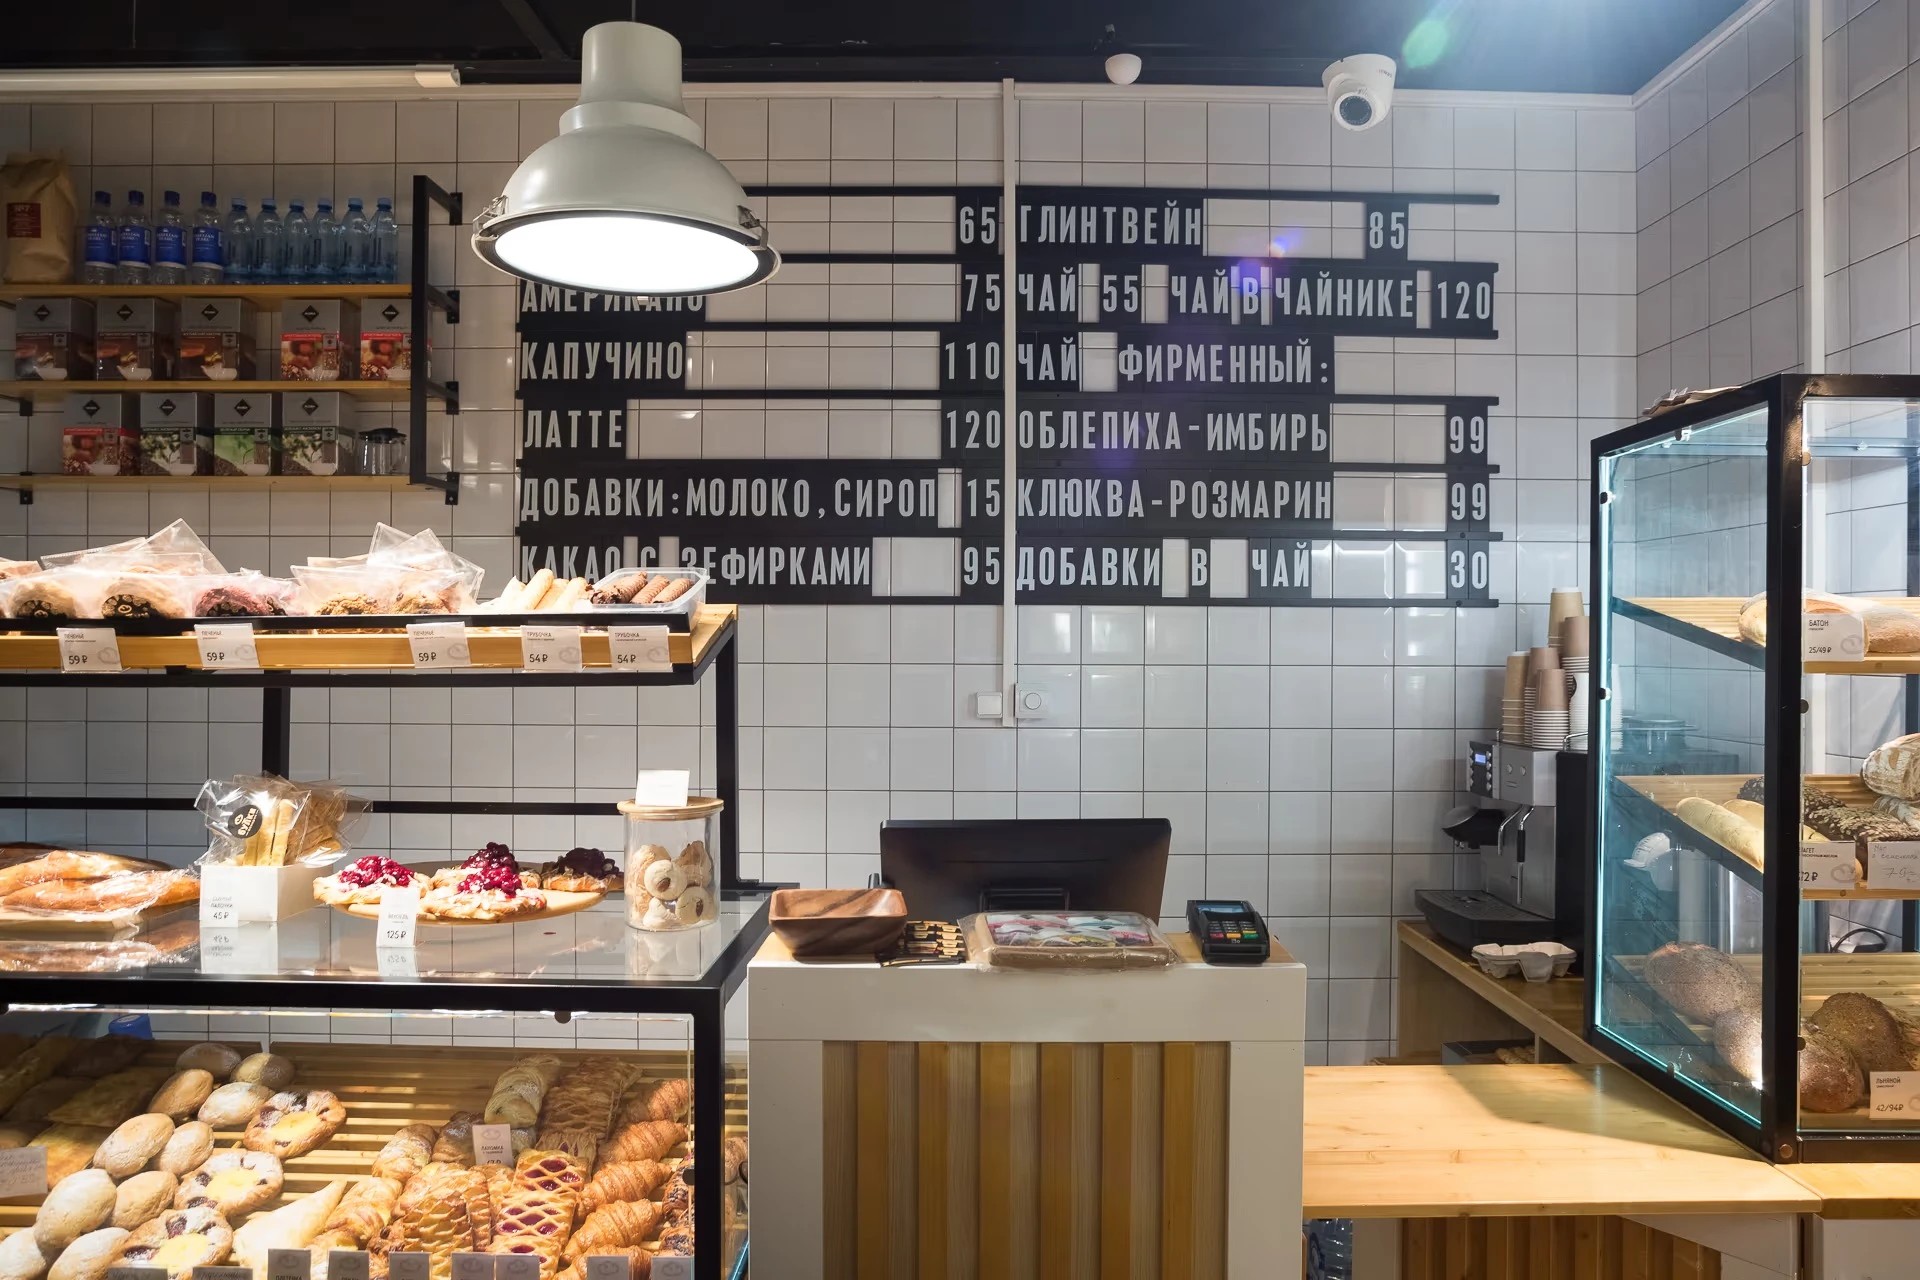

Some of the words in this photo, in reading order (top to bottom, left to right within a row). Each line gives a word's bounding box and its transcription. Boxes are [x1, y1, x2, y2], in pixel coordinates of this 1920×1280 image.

[960, 207, 997, 245] 65
[1020, 200, 1200, 246] ГЛИНТВЕЙН
[1369, 211, 1405, 249] 85
[966, 274, 1000, 311] 75
[1018, 267, 1076, 312] ЧАЙ
[1103, 275, 1139, 312] 55
[1171, 268, 1229, 314] ЧАЙ
[1243, 277, 1260, 315] В
[1275, 271, 1414, 318] ЧАЙНИКЕ
[1437, 281, 1491, 319] 120
[521, 342, 683, 380] КАПУЧИНО
[945, 342, 1000, 379] 110
[1018, 337, 1077, 381] ЧАЙ
[1118, 338, 1329, 384] ФИРМЕННЫЙ:
[524, 410, 622, 448] ЛАТТЕ
[947, 410, 1000, 448] 120
[1450, 416, 1485, 454] 99
[834, 479, 936, 517] СИРОП
[967, 479, 1000, 516] 15
[1451, 483, 1487, 520] 99
[521, 546, 621, 584] КАКАО
[681, 547, 871, 585] ЗЕФИРКАМИ
[963, 547, 1000, 585] 95
[1016, 546, 1161, 591] ДОБАВКИ
[1191, 549, 1208, 587] В
[1252, 543, 1310, 588] ЧАЙ
[1450, 550, 1487, 589] 30
[1808, 619, 1829, 627] БАТОН
[68, 655, 80, 665] 59
[206, 652, 218, 662] 59
[418, 652, 429, 662] 59
[529, 653, 541, 663] 54
[617, 654, 629, 663] 54
[1808, 646, 1827, 654] 25/49
[213, 911, 223, 920] 45
[386, 930, 400, 939] 125
